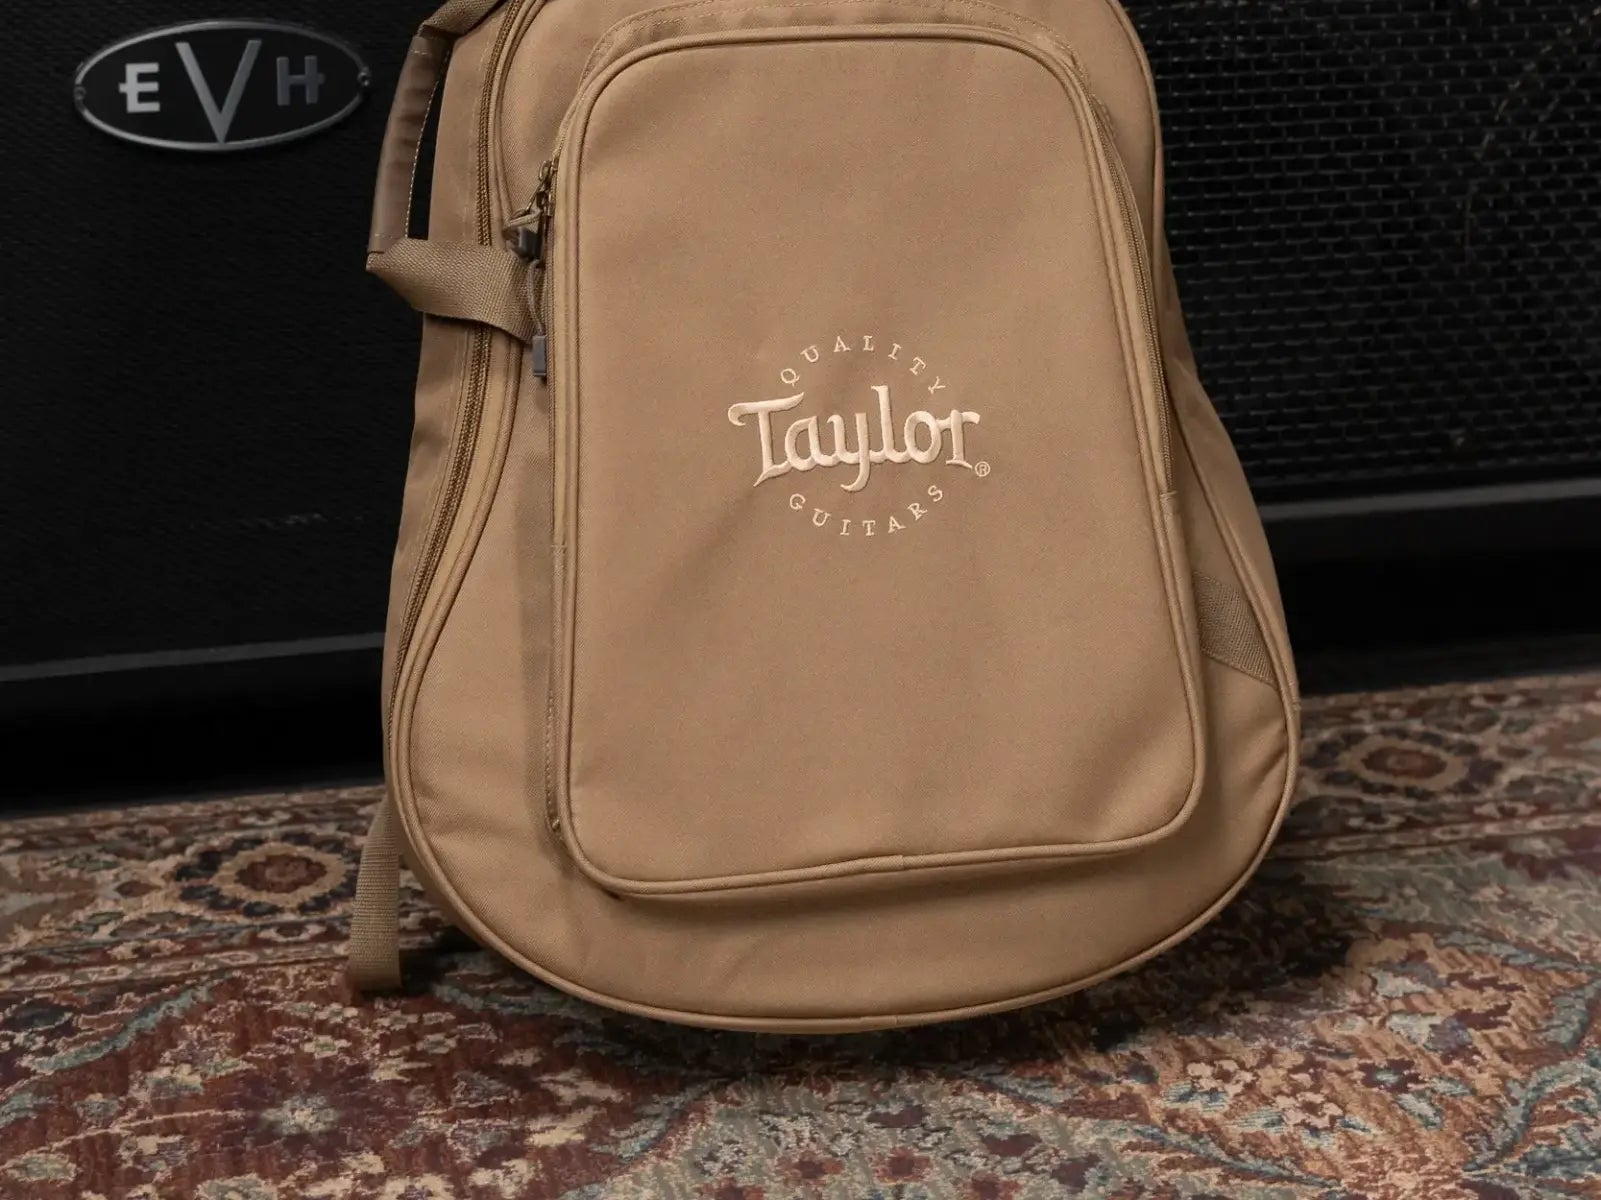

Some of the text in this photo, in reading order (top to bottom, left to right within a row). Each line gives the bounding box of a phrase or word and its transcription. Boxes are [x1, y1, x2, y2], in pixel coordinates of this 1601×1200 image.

[118, 39, 326, 145] EVH
[780, 335, 946, 395] QUALITY
[789, 485, 944, 537] GUITARS
